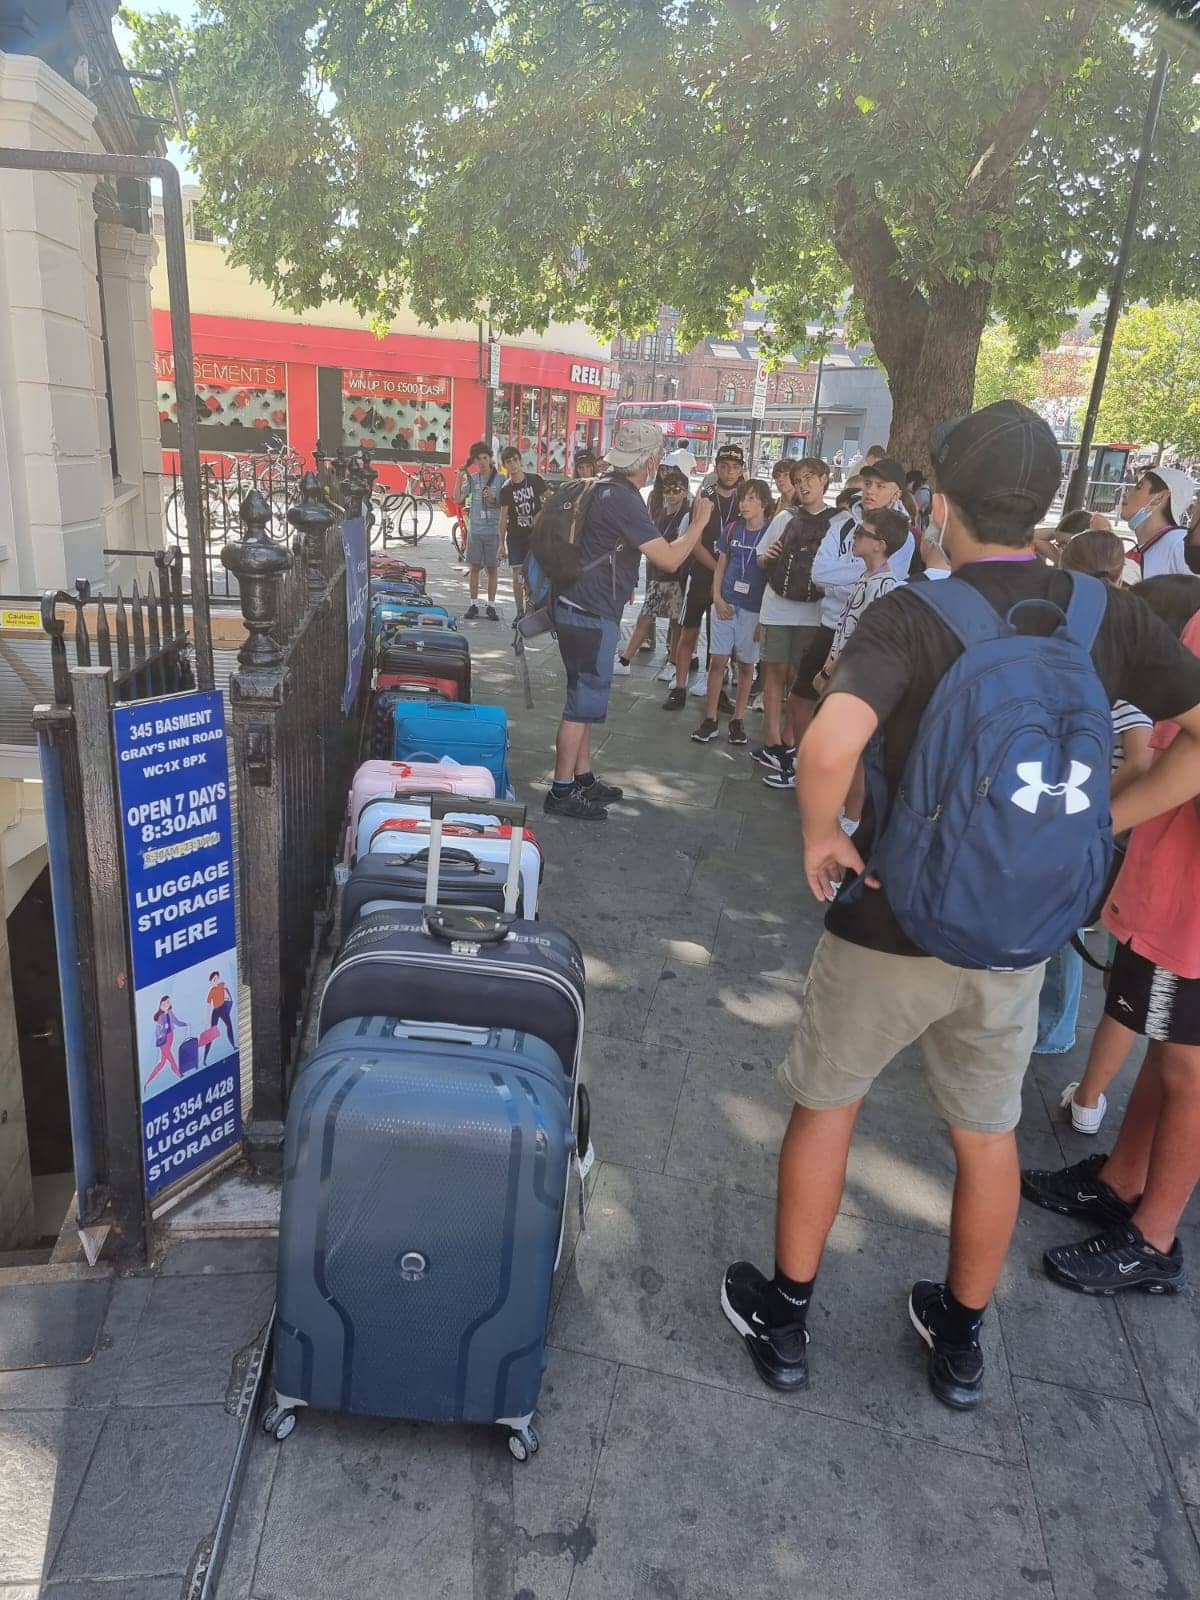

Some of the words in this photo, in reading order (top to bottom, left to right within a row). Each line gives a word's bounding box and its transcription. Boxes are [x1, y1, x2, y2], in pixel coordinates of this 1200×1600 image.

[154, 357, 276, 384] AMSEMENTS
[349, 377, 366, 389] WIN
[368, 380, 380, 391] UP
[384, 381, 395, 392] TO
[397, 382, 418, 394] £500
[420, 384, 445, 395] CASH
[571, 364, 601, 386] REEL
[130, 722, 152, 740] 345
[156, 710, 212, 735] BASMENT
[121, 742, 165, 761] GRAY'S
[168, 736, 189, 750] INN
[192, 729, 223, 744] ROAD
[143, 760, 180, 778] WC1X
[183, 753, 207, 767] 8PX
[127, 798, 172, 826] OPEN
[175, 794, 184, 812] 7
[189, 782, 226, 809] DAYS
[141, 804, 217, 843] 8:30AM
[135, 861, 229, 909] LUGGAGE
[137, 884, 230, 932] STORAGE
[155, 916, 218, 958] HERE
[344, 924, 422, 949] REENWICH
[146, 1112, 169, 1139] 075
[172, 1093, 202, 1124] 3354
[205, 1076, 234, 1104] 4428
[147, 1099, 234, 1161] LUGGAGE
[149, 1119, 235, 1181] STORAGE
